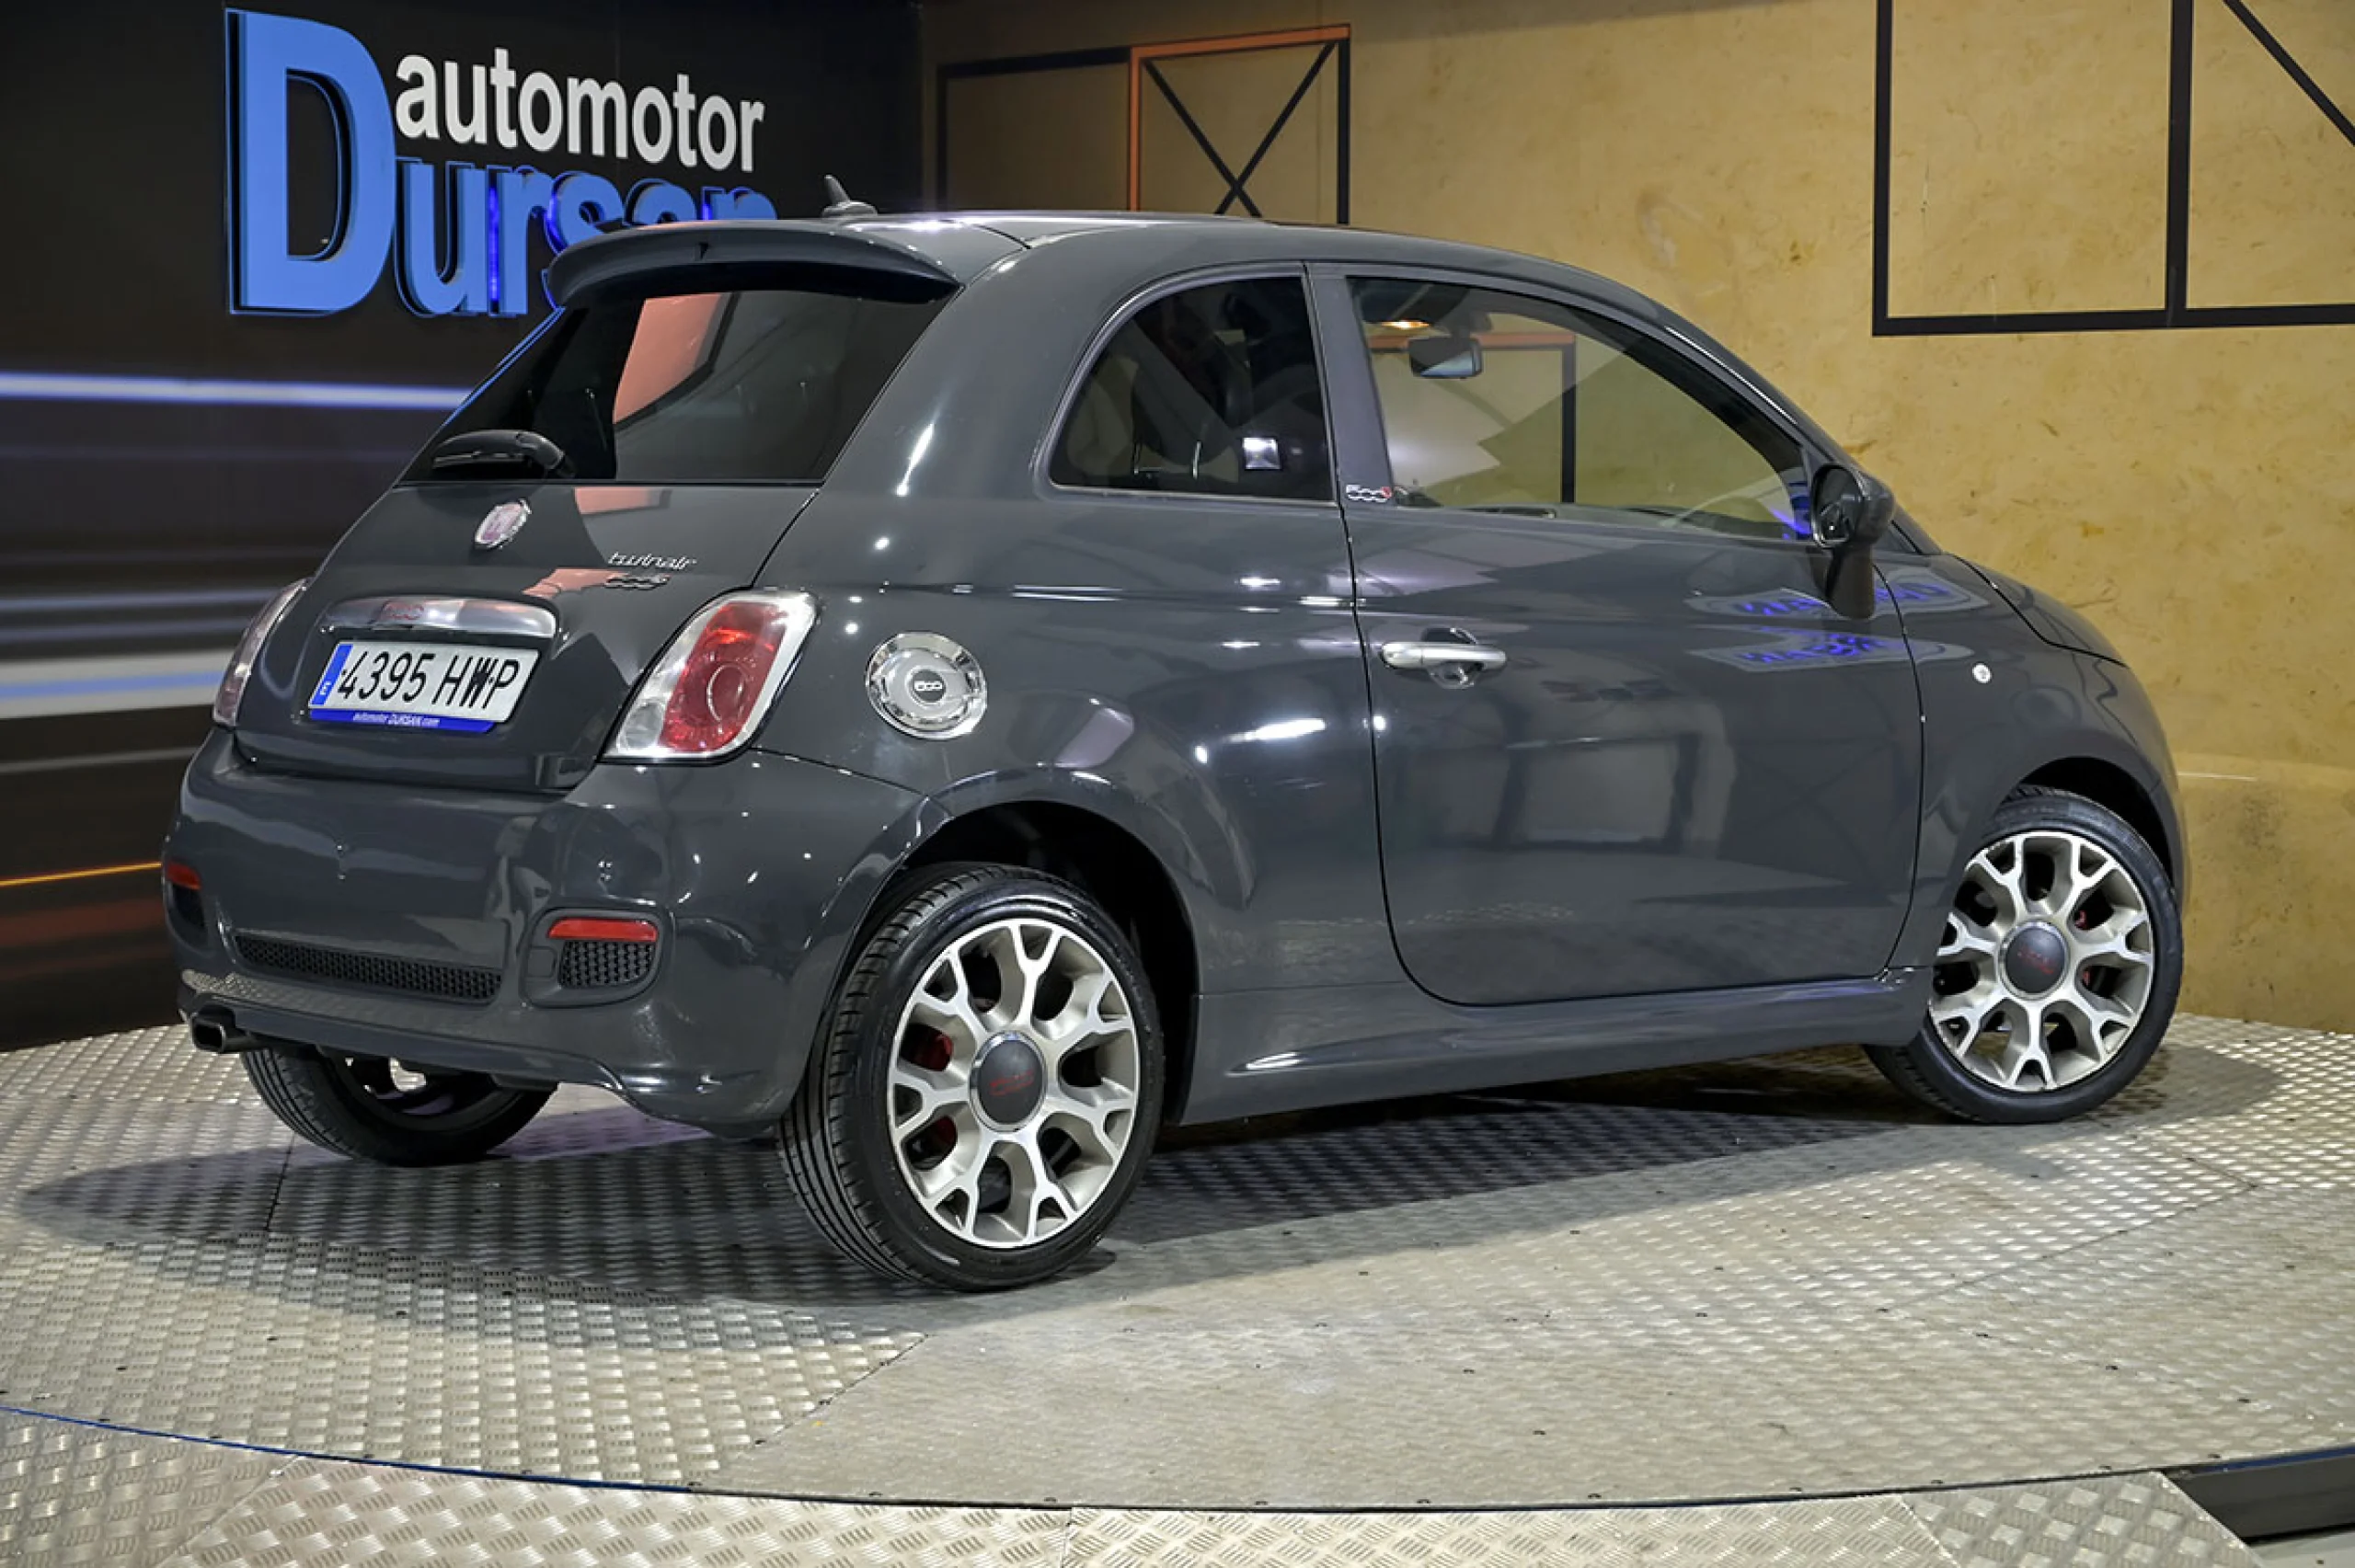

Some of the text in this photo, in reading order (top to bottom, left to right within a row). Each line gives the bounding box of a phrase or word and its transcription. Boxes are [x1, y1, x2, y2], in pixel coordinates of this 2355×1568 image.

[225, 7, 777, 316] Durs
[396, 48, 764, 171] automotor
[338, 651, 435, 703] 4395
